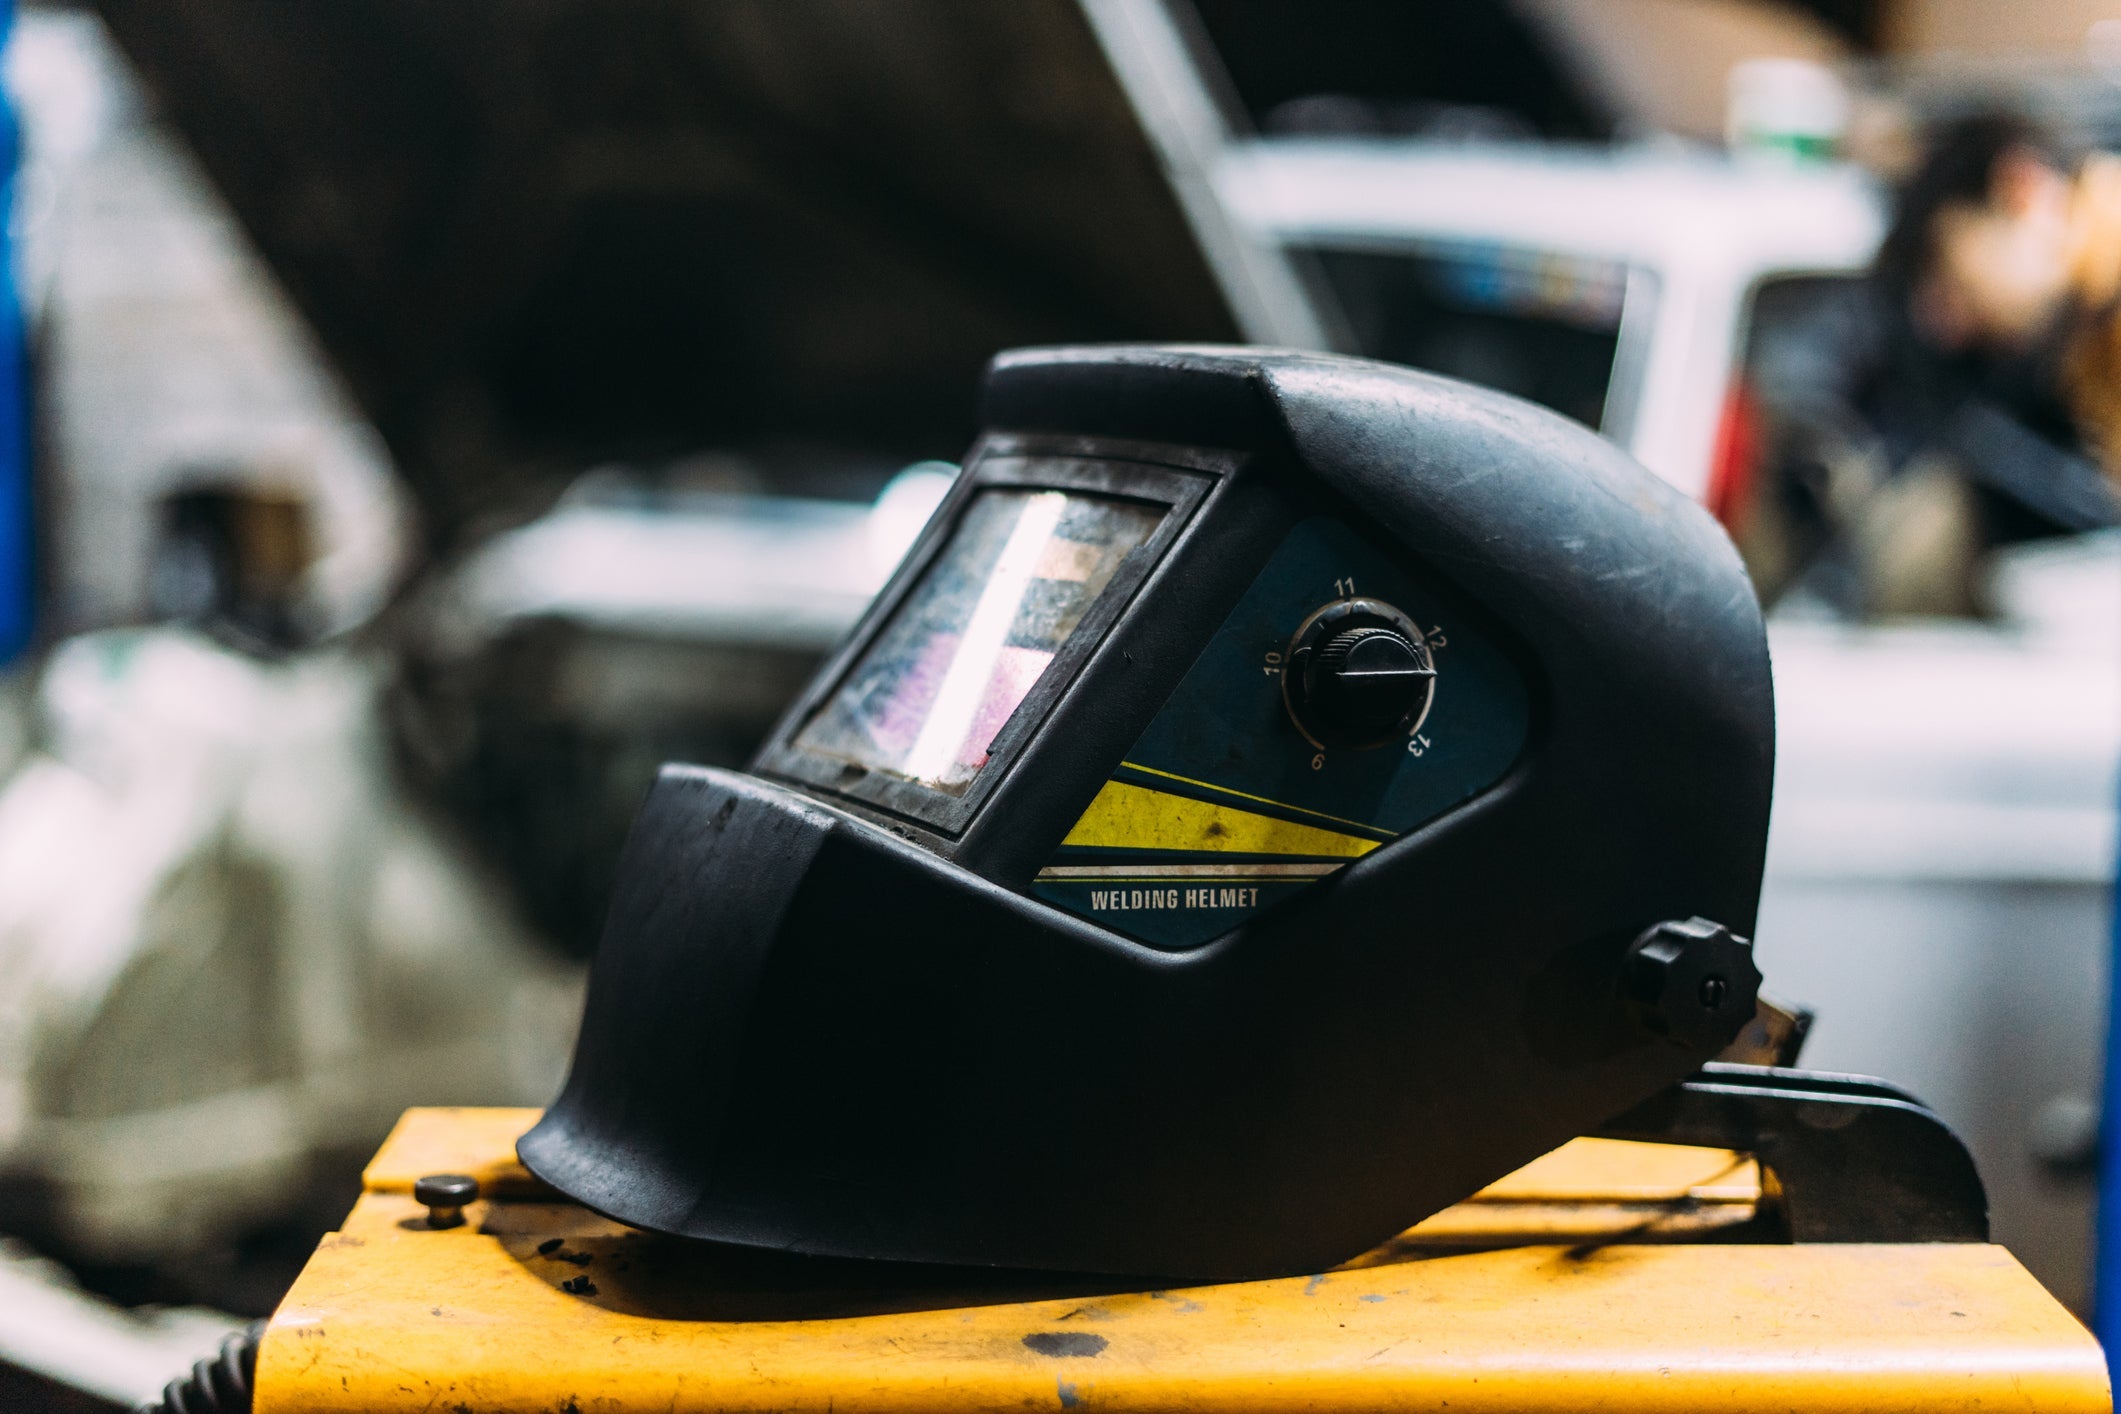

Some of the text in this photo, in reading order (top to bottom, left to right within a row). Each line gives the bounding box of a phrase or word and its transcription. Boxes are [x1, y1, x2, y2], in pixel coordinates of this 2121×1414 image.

[1334, 577, 1355, 597] 11
[1427, 625, 1447, 650] 12
[1263, 652, 1282, 677] 10
[1407, 734, 1431, 757] 13
[1091, 888, 1259, 911] WELDING HELMET
